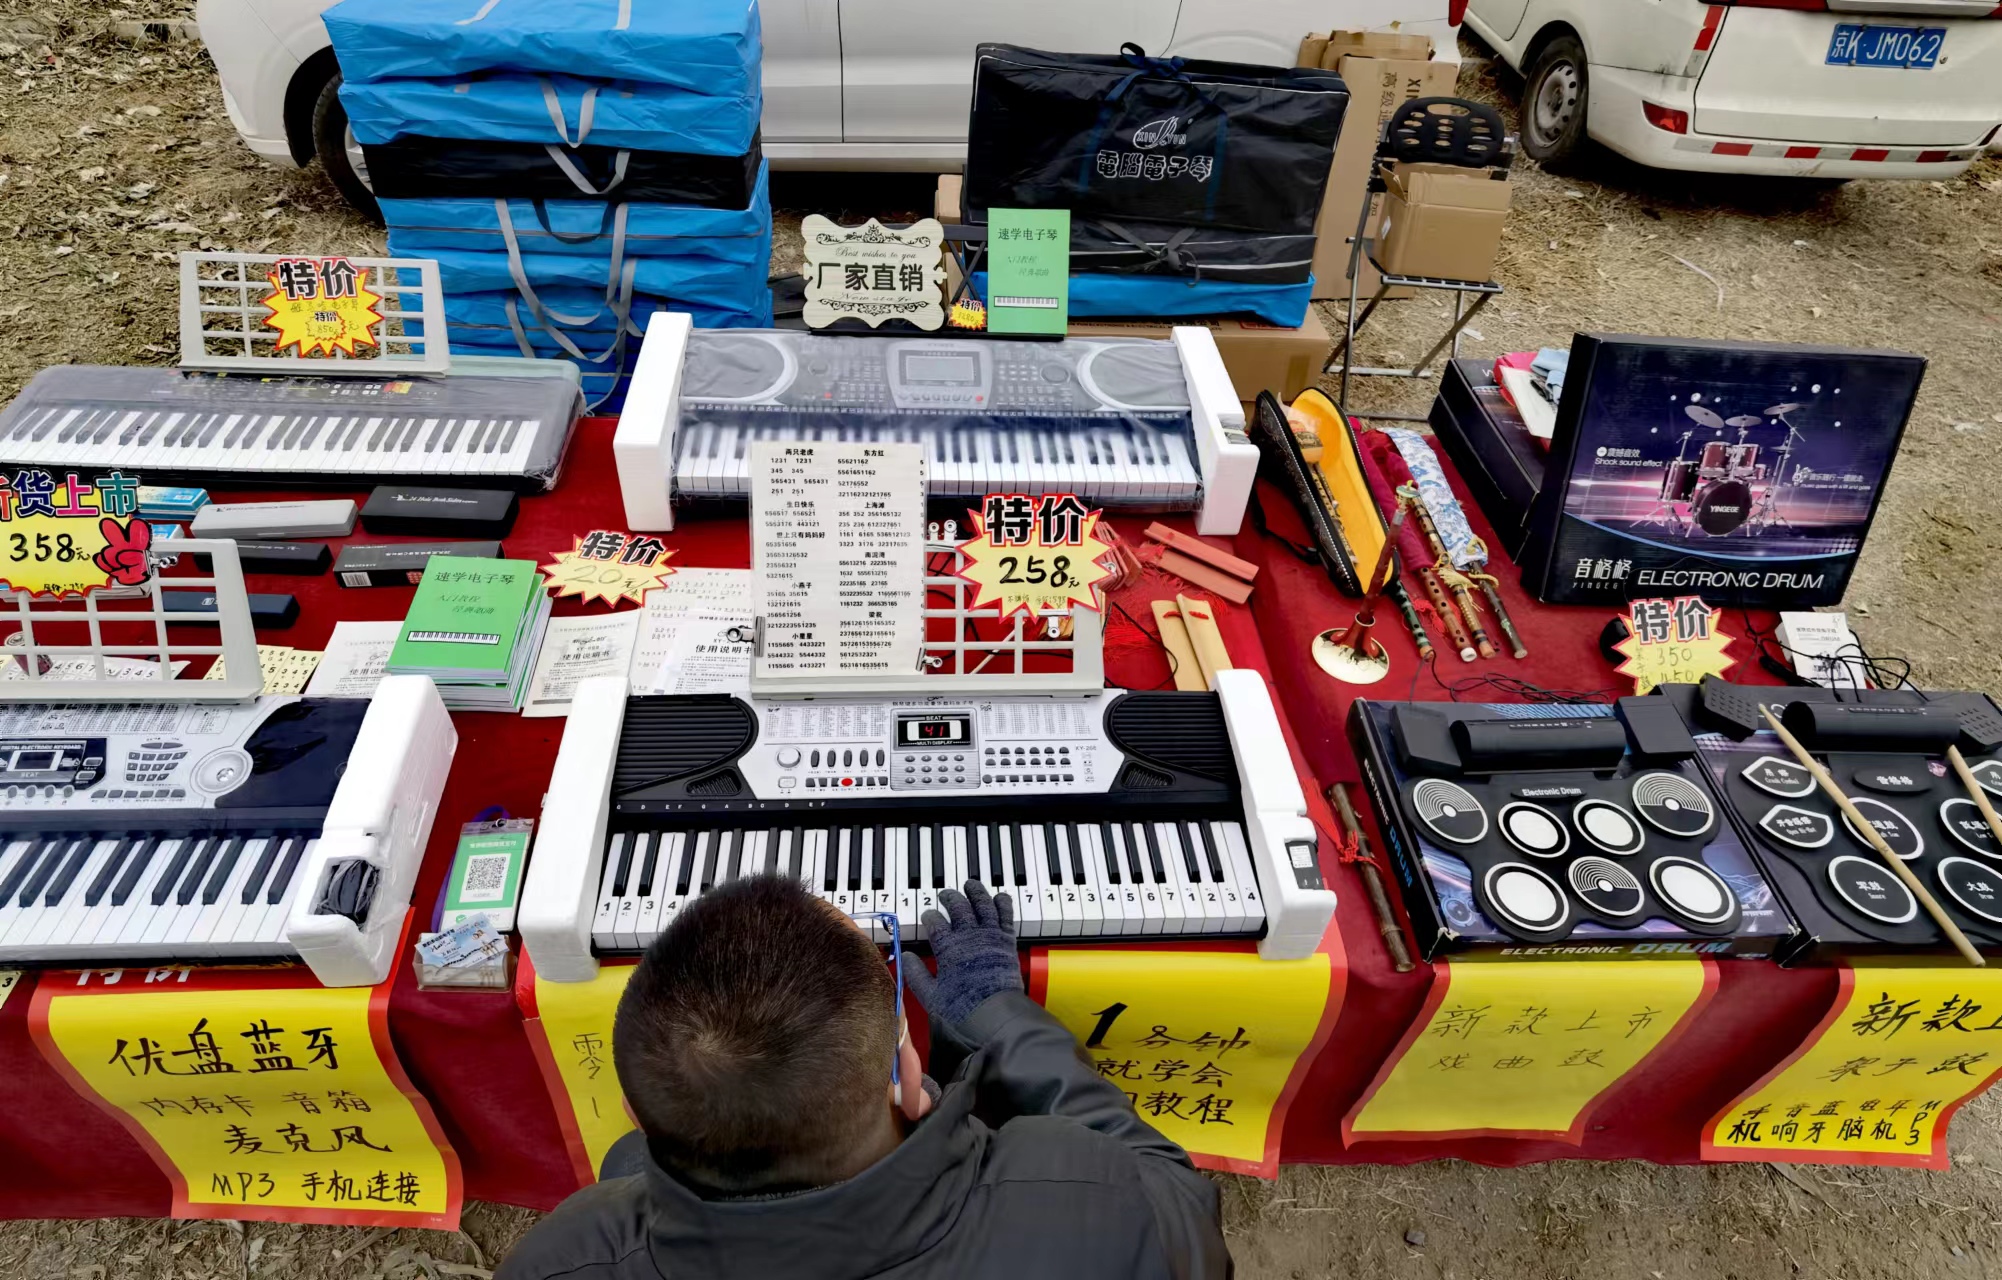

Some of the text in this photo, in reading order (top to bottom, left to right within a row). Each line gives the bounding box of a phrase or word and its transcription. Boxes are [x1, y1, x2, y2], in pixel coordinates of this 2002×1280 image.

[1097, 150, 1213, 182] 電腦電子琴
[998, 227, 1058, 241] 速学电子琴
[278, 259, 359, 299] 特价
[816, 262, 923, 292] 厂家直销
[785, 448, 814, 456] 两只老虎
[1594, 457, 1618, 466] Shock
[986, 497, 1086, 545] 特价
[1709, 504, 1740, 514] YINGEGE
[580, 530, 665, 566] 特价
[434, 571, 516, 585] 速学电子琴
[1574, 557, 1632, 580] 音格格
[1637, 569, 1825, 589] ELECTRONIC DRUM
[1632, 597, 1703, 644] 特价
[1657, 645, 1693, 667] 350
[1522, 786, 1582, 797] Electronic Drum
[1389, 825, 1413, 888] DRUM
[1966, 881, 1994, 892] 大鼓
[603, 892, 1256, 911] 1 2 3 4 5 6 7 1 2 7 1 2 3 4 5 6 7 1 2 3 4
[1500, 942, 1733, 956] ELECTRONIC DRUM
[1431, 1004, 1662, 1039] 新款上市
[108, 1018, 339, 1077] 优盘蓝牙
[1428, 1048, 1605, 1072] 戏曲鼓
[140, 1089, 372, 1117] 内存卡 音箱
[223, 1123, 394, 1155] 麦克风
[211, 1169, 420, 1207] MP3 手机连接
